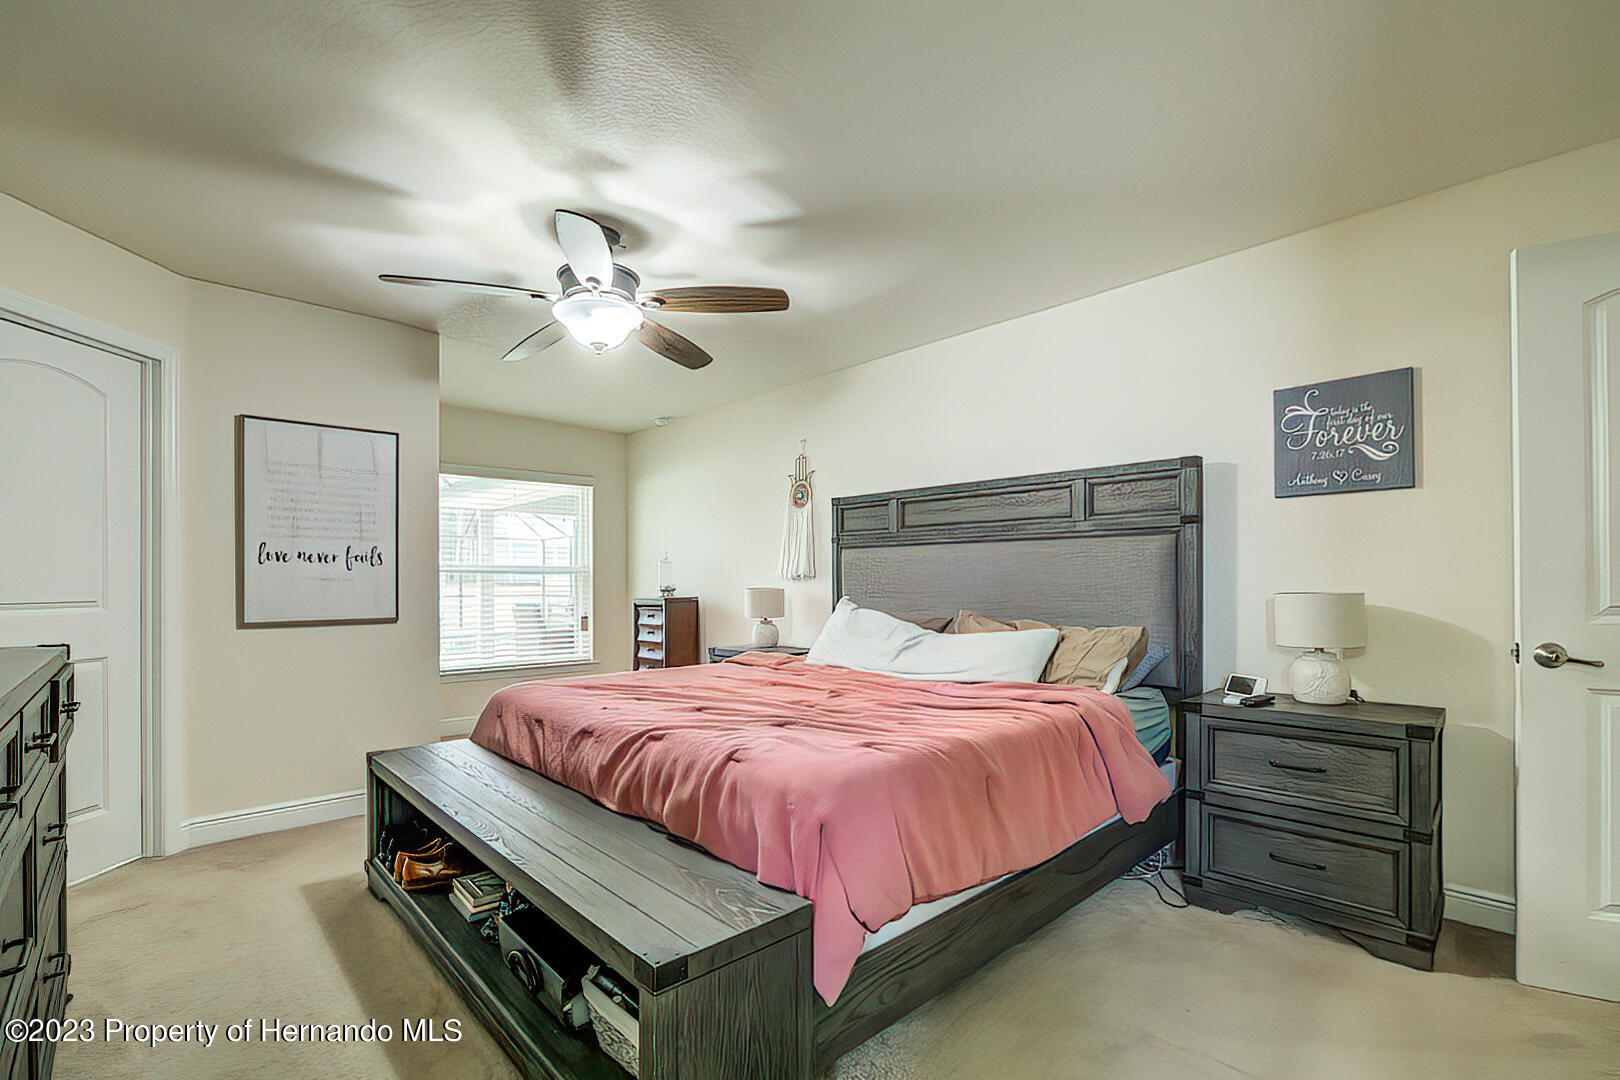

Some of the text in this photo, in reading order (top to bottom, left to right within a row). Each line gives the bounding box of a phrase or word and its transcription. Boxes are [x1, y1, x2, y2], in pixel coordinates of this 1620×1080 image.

[1281, 389, 1404, 450] Forever
[1330, 405, 1351, 418] today
[1346, 413, 1363, 426] day
[1364, 408, 1375, 424] of
[1376, 412, 1394, 421] our
[258, 542, 384, 571] love never fails
